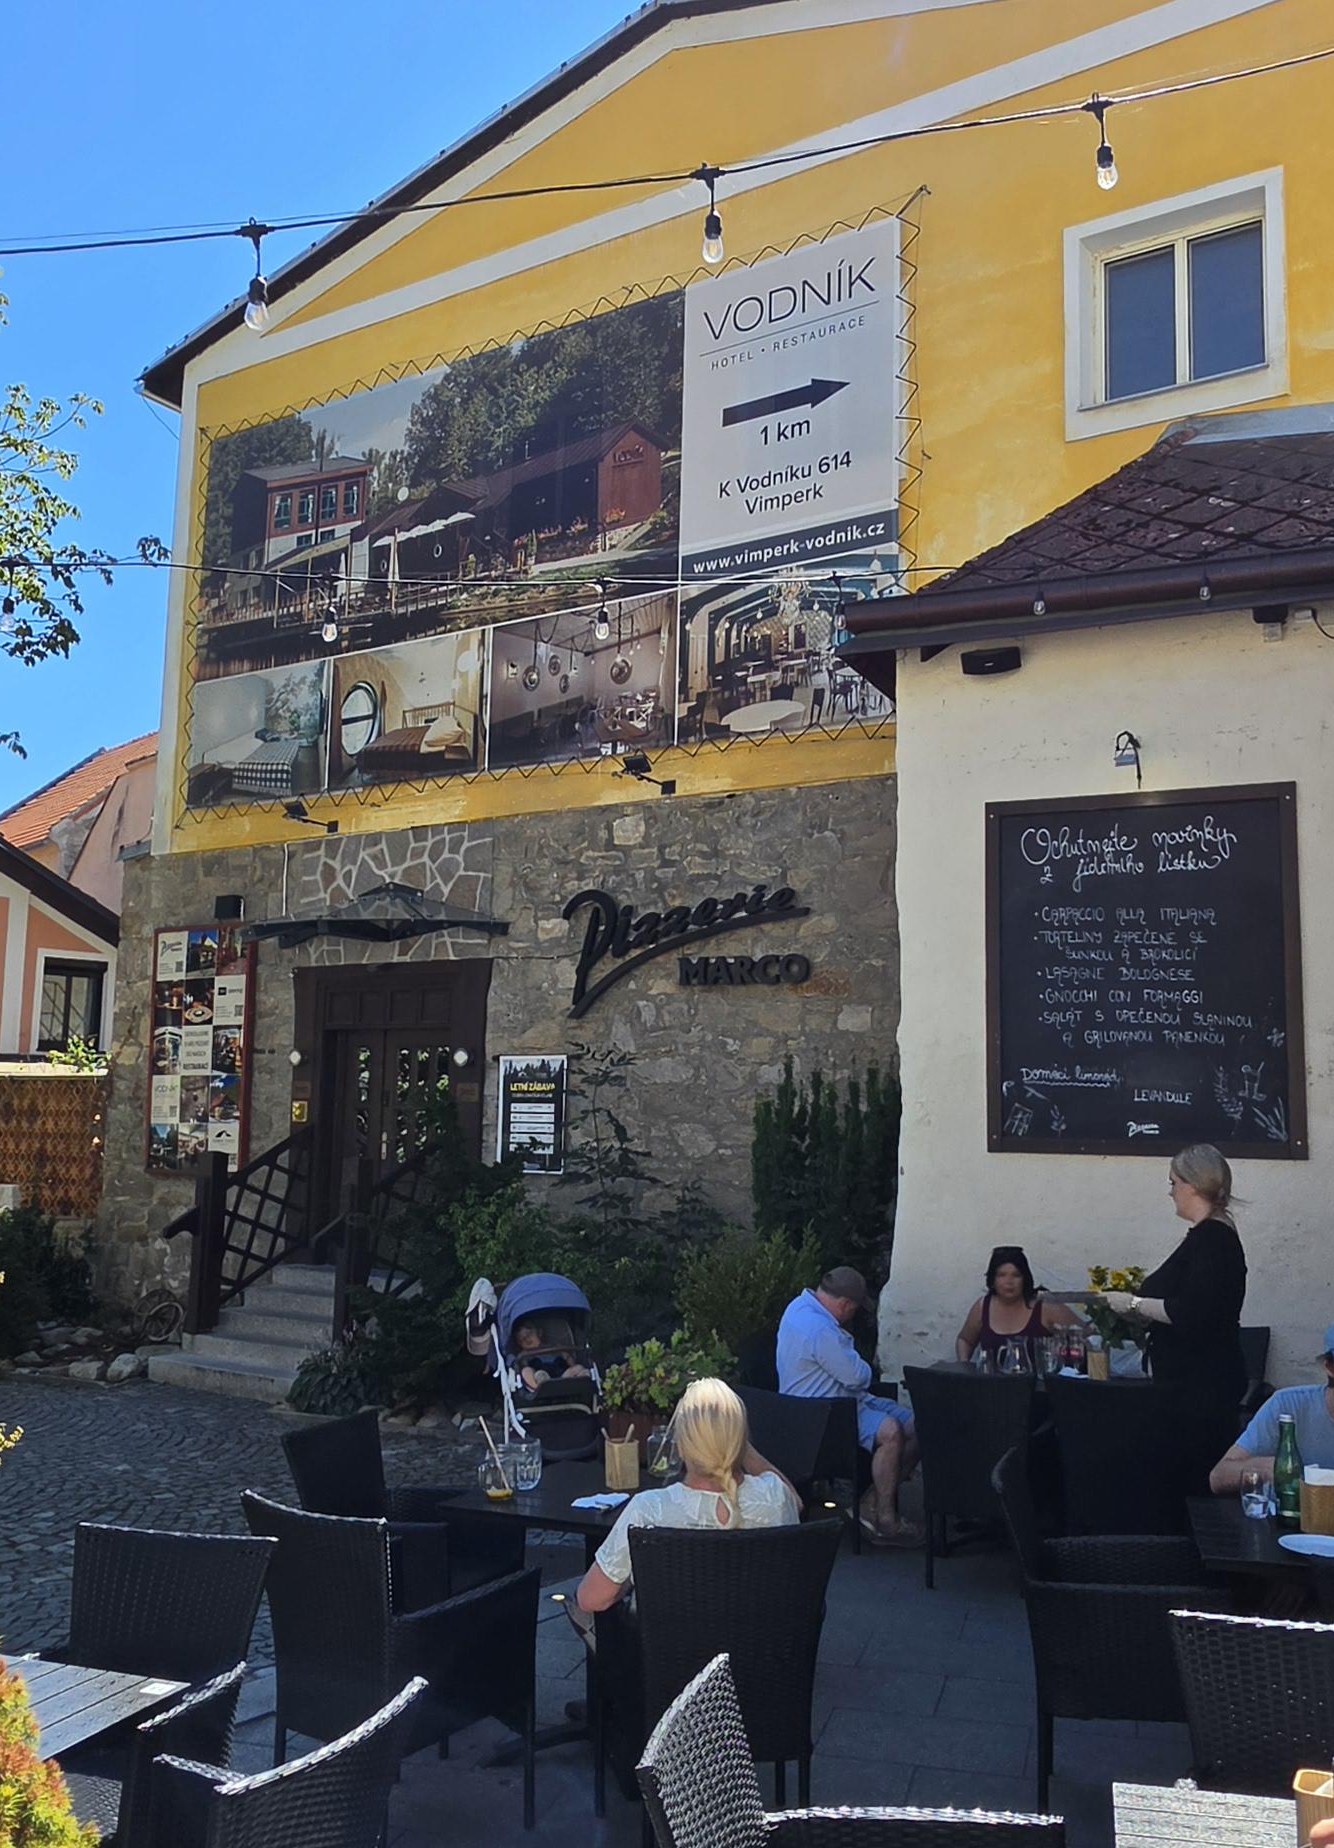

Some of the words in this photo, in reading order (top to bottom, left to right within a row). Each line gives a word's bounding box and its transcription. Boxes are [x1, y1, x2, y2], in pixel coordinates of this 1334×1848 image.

[703, 256, 877, 341] VODNÍK
[710, 351, 754, 371] HOTEL
[772, 314, 867, 352] RESTAURACE
[760, 425, 769, 446] 1
[777, 418, 811, 443] km
[719, 480, 731, 499] K
[736, 463, 813, 494] Vodníku
[818, 450, 852, 475] 614
[745, 482, 824, 515] Vimperk
[692, 521, 886, 575] www.vimperk-vodnik.cz
[1116, 907, 1147, 926] ALLA
[1159, 907, 1217, 926] ITALIANA
[1188, 931, 1208, 944] SE
[1122, 948, 1131, 964] A
[677, 952, 814, 986] MARCO
[1045, 967, 1105, 986] LASAGNE
[1119, 967, 1195, 981] BOLOGNESE
[1045, 988, 1097, 1004] GNOCCHI
[1108, 990, 1131, 1002] CON
[1143, 989, 1203, 1011] FORMAGGI
[1095, 1010, 1104, 1022] S
[1133, 1088, 1193, 1105] LEVANDULE
